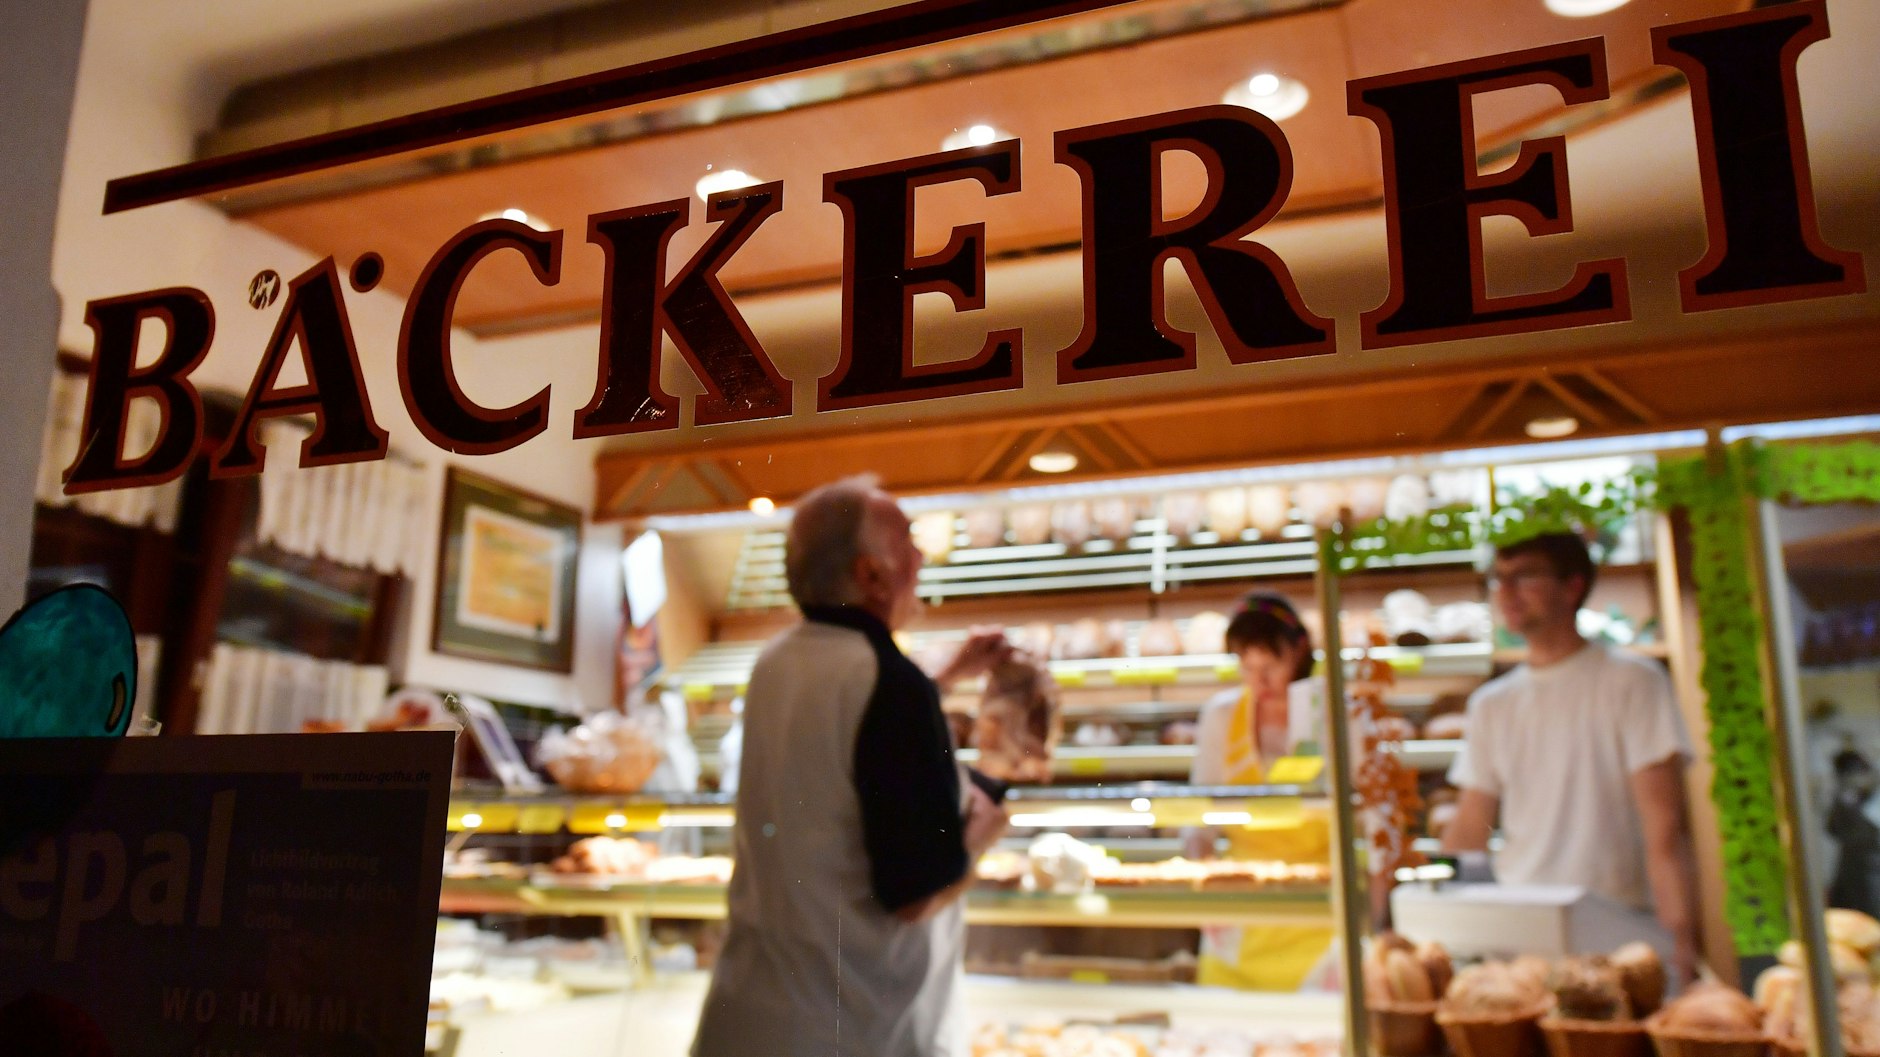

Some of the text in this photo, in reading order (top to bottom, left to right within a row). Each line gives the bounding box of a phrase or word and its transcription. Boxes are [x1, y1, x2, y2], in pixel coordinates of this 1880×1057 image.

[62, 0, 1867, 496] BÄCKEREI
[312, 769, 432, 785] www.nabu-gotha.de
[245, 883, 277, 898] von
[281, 880, 339, 899] Roland
[162, 987, 217, 1023] WO
